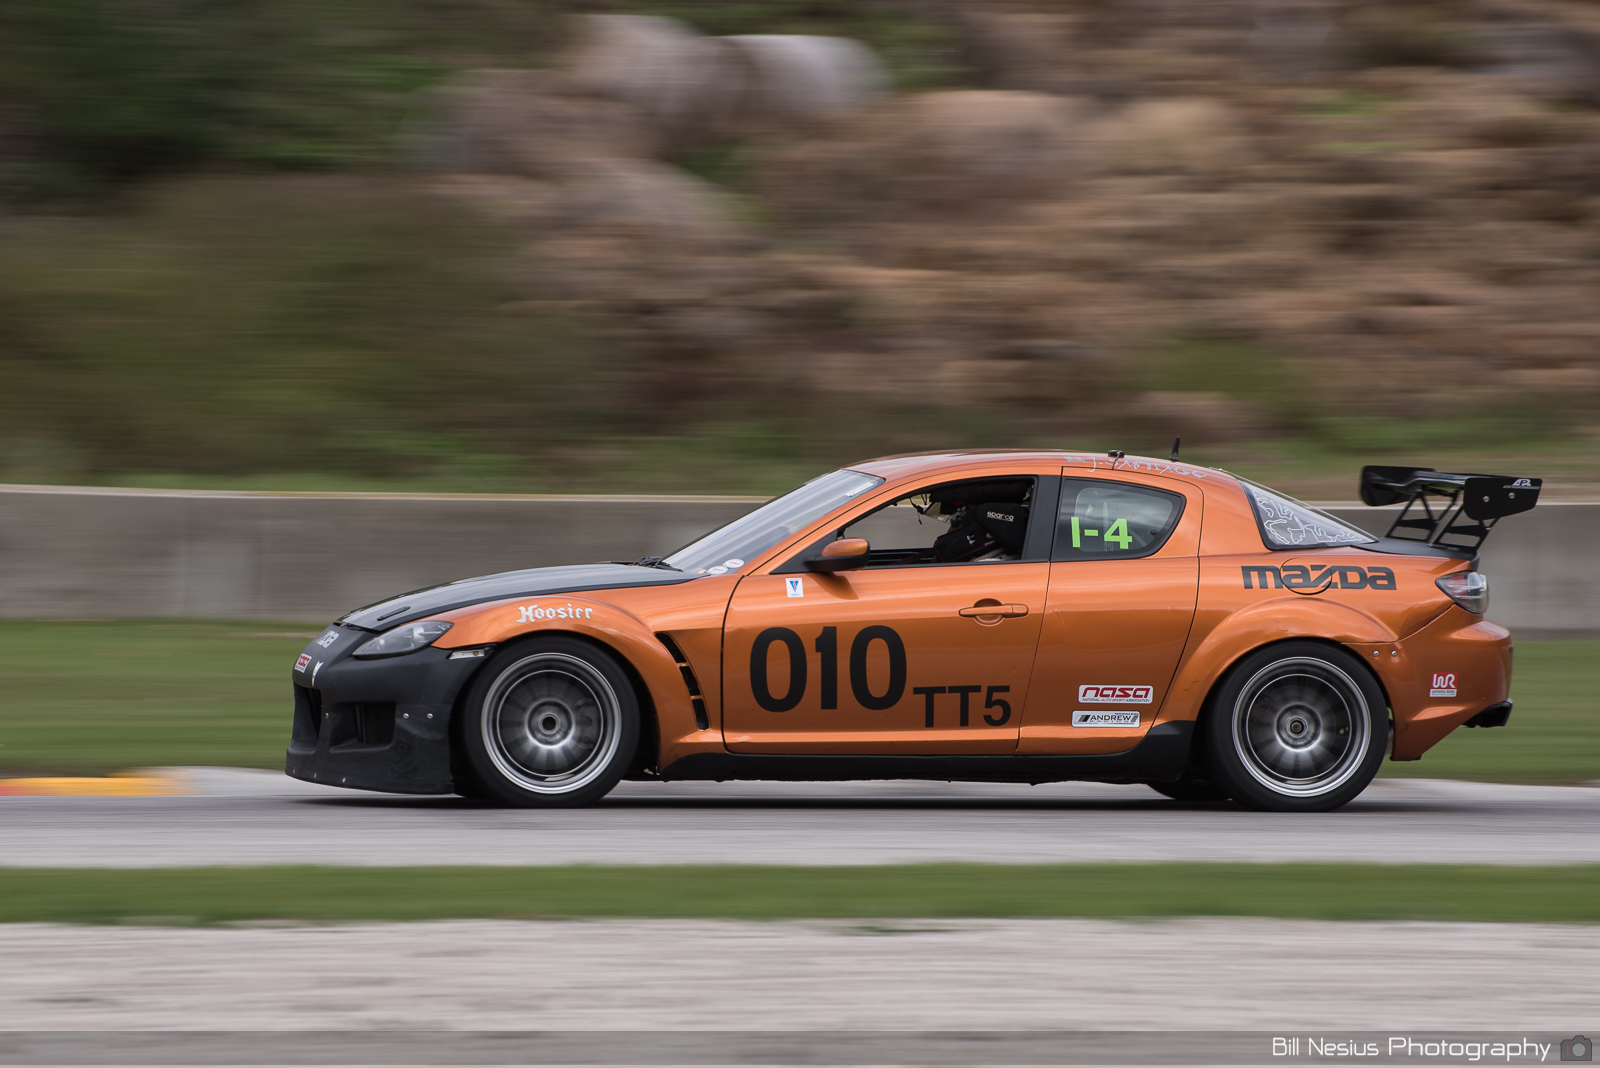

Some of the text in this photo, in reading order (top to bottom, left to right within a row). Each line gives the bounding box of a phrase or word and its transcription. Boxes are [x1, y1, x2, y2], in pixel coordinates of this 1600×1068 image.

[515, 602, 593, 623] Hoosier
[749, 625, 907, 713] 010
[912, 685, 1012, 728] TT5
[1082, 687, 1151, 698] nasa
